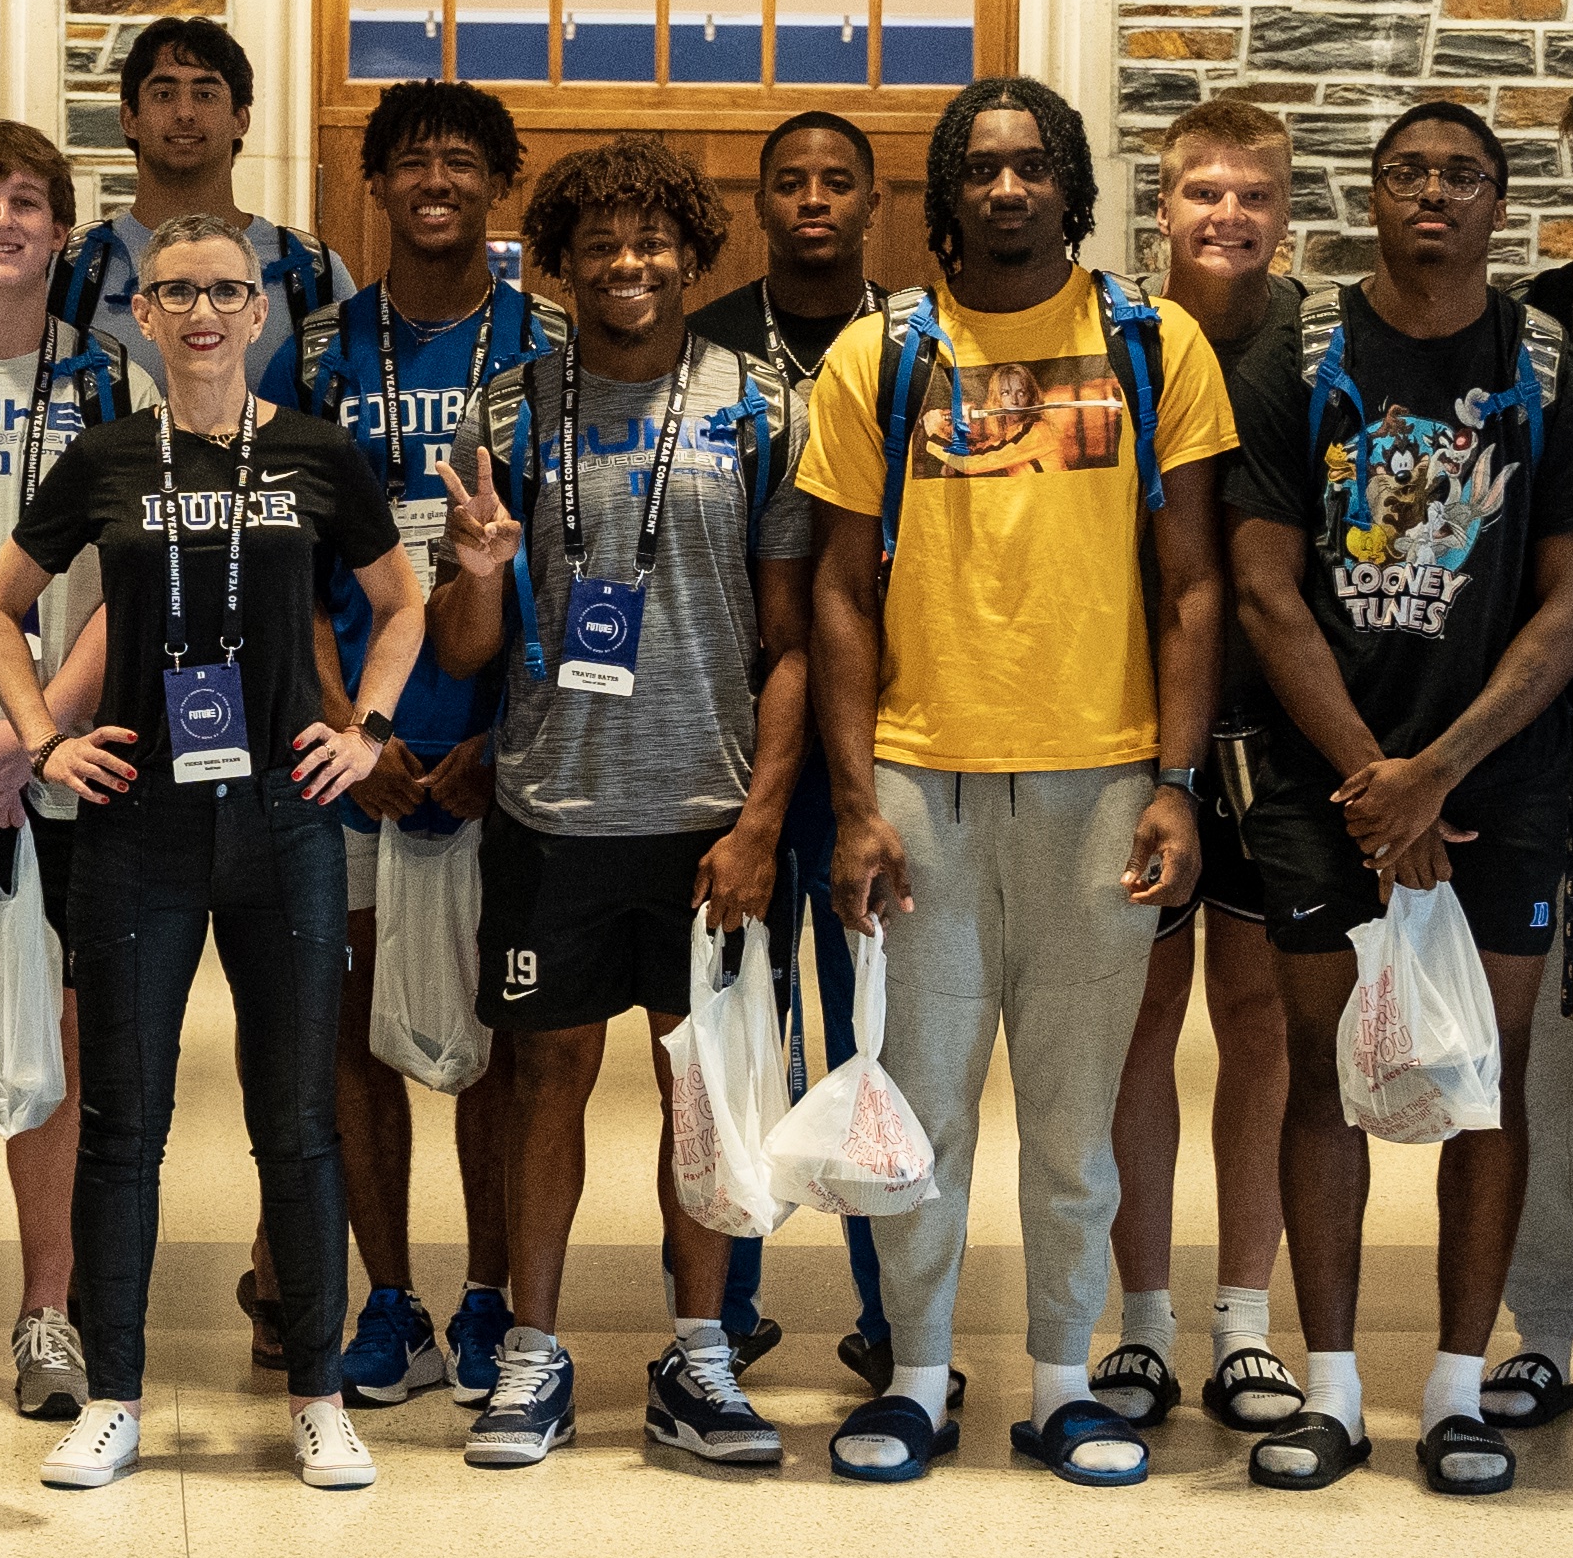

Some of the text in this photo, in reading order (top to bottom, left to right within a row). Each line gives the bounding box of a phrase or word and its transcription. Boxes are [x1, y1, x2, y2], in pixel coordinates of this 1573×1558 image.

[565, 367, 574, 382] 40
[32, 398, 46, 440] 40 YEAR
[340, 390, 464, 434] FOOTB
[384, 359, 401, 465] 40 YEAR COMMITMENT
[241, 419, 254, 459] 40 YEAR
[563, 416, 576, 530] 40 YEAR COMMITMENT
[645, 419, 678, 535] 40 YEAR COMMITMENT
[142, 491, 301, 530] DUKE
[166, 500, 181, 618] 40 YEAR COMMITMENT
[228, 493, 245, 611] 40 YEAR COMMITMENT
[1334, 562, 1471, 603] LOONEY
[1345, 596, 1446, 634] TUNES
[571, 670, 596, 679] TRAVIS
[505, 948, 537, 985] 19
